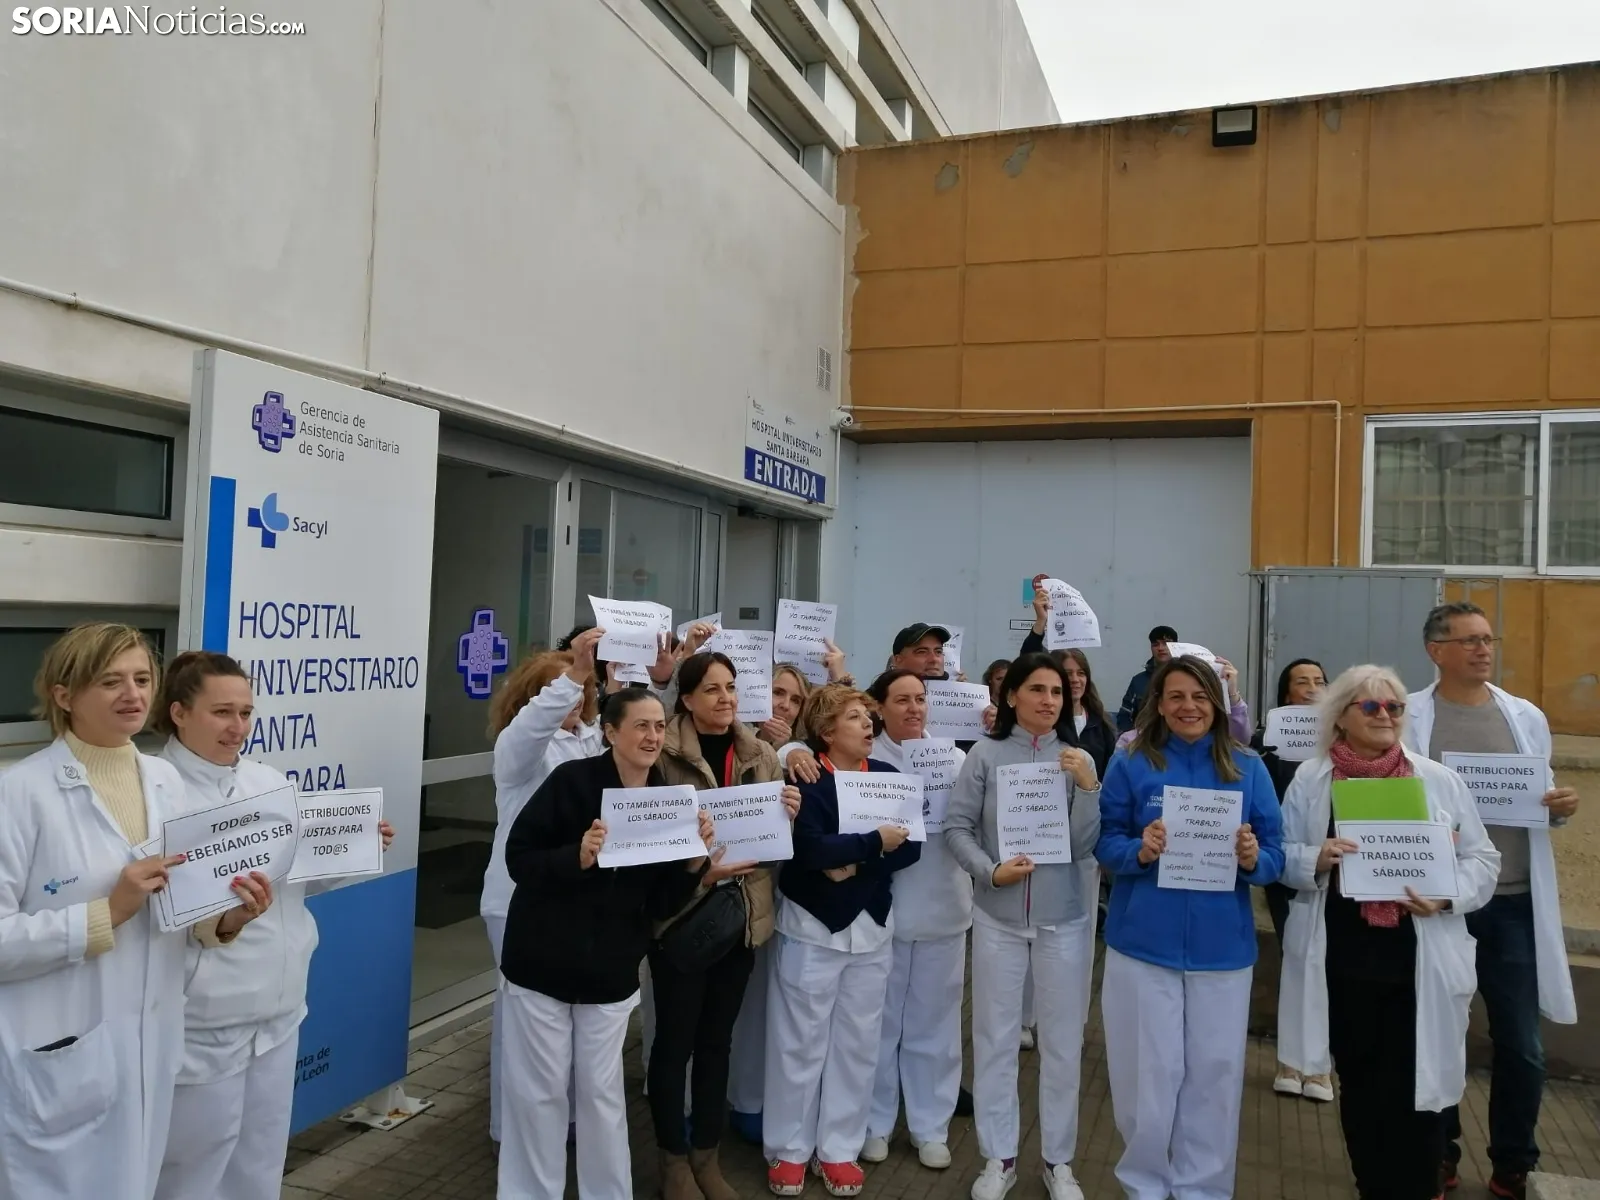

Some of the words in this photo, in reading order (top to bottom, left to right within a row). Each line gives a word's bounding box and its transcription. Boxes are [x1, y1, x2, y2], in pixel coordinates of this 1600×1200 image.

[300, 401, 349, 424] Gerencia
[352, 414, 366, 428] de
[300, 421, 353, 444] Asistencia
[357, 433, 400, 454] Sanitaria
[751, 418, 780, 440] HOSPITAL
[782, 431, 822, 458] UNIVERSITARIO
[299, 440, 313, 456] de
[317, 444, 345, 462] Soria
[766, 440, 785, 456] SANTA
[754, 453, 817, 499] ENTRADA
[293, 516, 328, 539] Sacyl
[239, 601, 361, 640] HOSPITAL
[1279, 728, 1316, 736] TRABAJO
[912, 759, 955, 768] trabajamos
[931, 771, 943, 779] los
[1456, 765, 1535, 776] RETRIBUCIONES
[856, 781, 887, 789] TAMBIÉN
[889, 783, 916, 793] TRABAJO
[923, 781, 957, 792] ábados?
[1022, 777, 1054, 785] TAMBIÉN
[1500, 781, 1528, 791] PARA
[874, 791, 905, 800] SÁBADOS
[1015, 791, 1049, 799] TRABAJO
[1476, 796, 1513, 805] TOD@S
[612, 802, 624, 811] YO
[625, 799, 660, 810] TAMBIÉN
[661, 798, 693, 808] TRABAJO
[709, 799, 744, 809] TAMBIÉN
[745, 794, 778, 805] TRABAJO
[713, 812, 728, 821] LOS
[729, 809, 764, 819] SÁBADOS
[1008, 805, 1023, 813] LOS
[1178, 804, 1190, 812] YO
[1193, 804, 1229, 814] TAMBIÉN
[211, 811, 261, 833] TOD@S
[627, 814, 642, 823] LOS
[643, 812, 678, 821] SÁBADOS
[1184, 818, 1221, 828] TRABAJO
[338, 823, 363, 835] PARA
[727, 838, 757, 846] movemos
[1192, 831, 1230, 841] SÁBADOS
[1360, 834, 1376, 844] YO
[1379, 832, 1430, 845] TAMBIÉN
[187, 832, 269, 863] EBERÍAMOS
[272, 823, 293, 840] SER
[637, 840, 667, 849] movemos
[313, 843, 349, 856] TOD@S
[1360, 851, 1411, 861] TRABAJO
[1414, 851, 1435, 861] LOS
[213, 852, 270, 878] IGUALES
[1372, 866, 1426, 878] SÁBADOS
[317, 1047, 331, 1060] de
[302, 1062, 330, 1082] León
